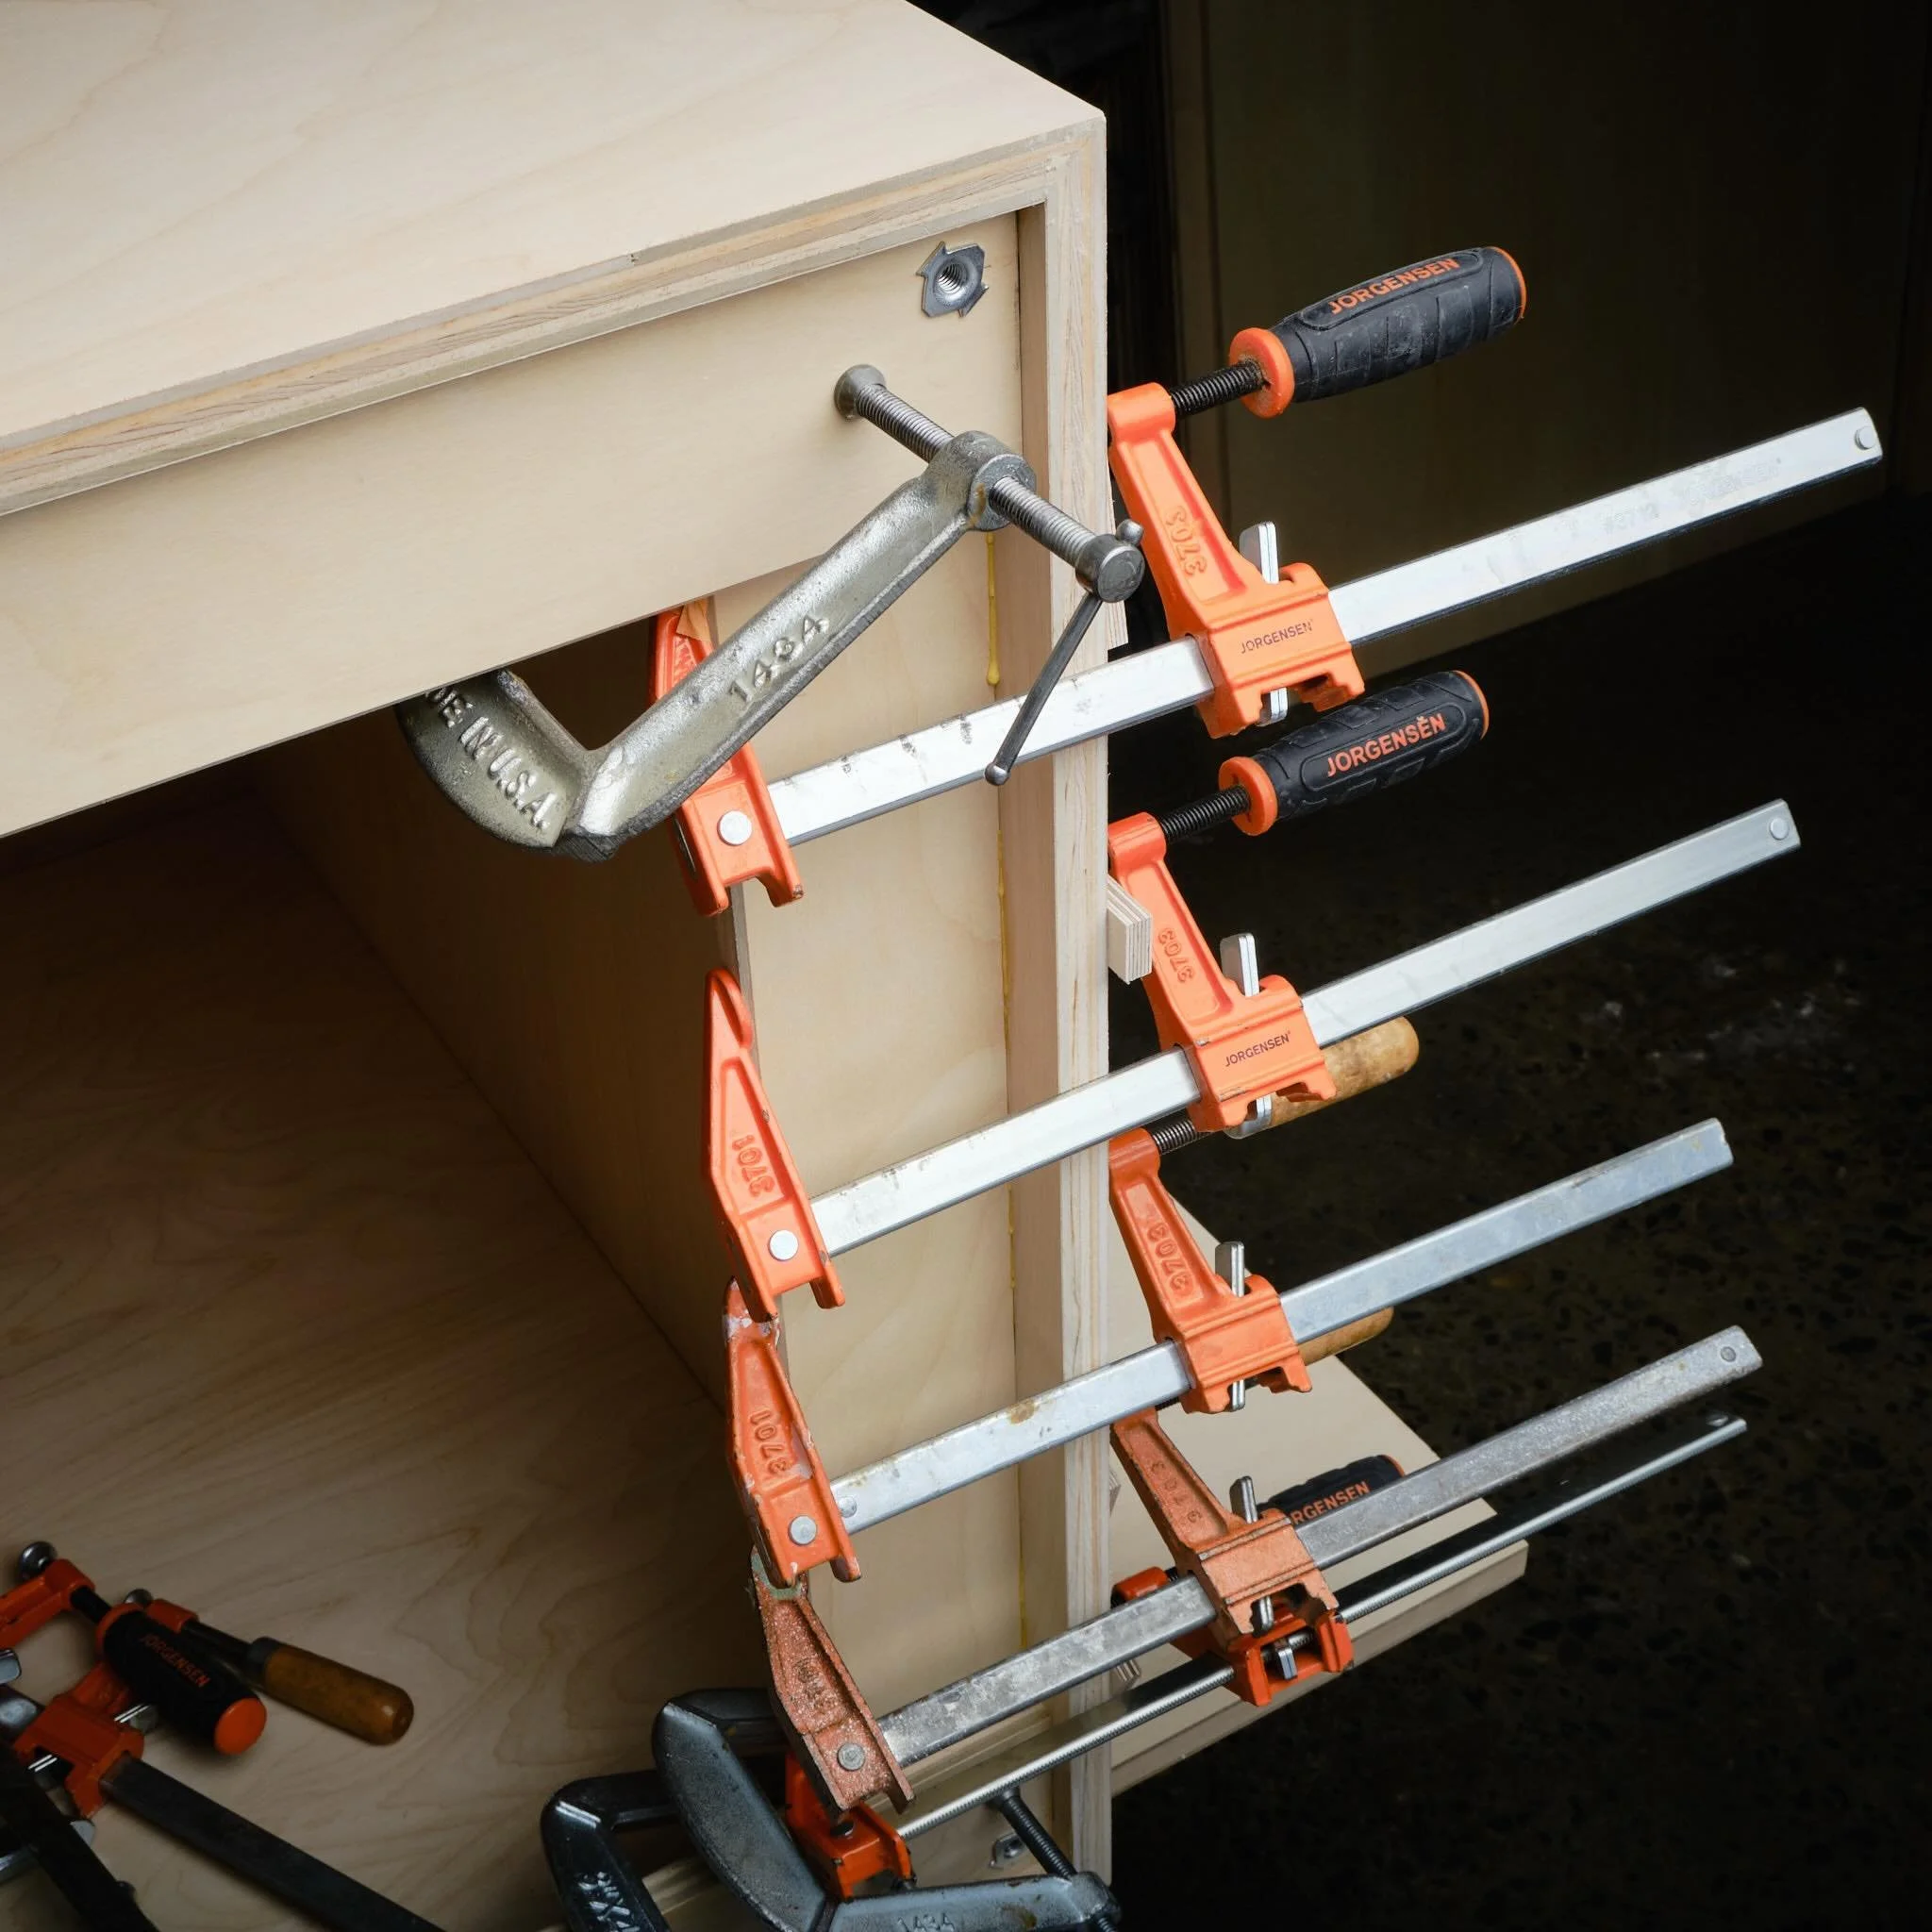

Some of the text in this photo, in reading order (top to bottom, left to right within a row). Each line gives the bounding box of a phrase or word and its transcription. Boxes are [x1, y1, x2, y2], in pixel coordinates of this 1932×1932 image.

[1329, 257, 1460, 315] JORGENSEN
[1165, 506, 1208, 578] 3703
[1241, 621, 1313, 654] JORGENSEN
[459, 716, 503, 759] IN
[1326, 712, 1446, 776] JORGENSEN
[1158, 927, 1195, 984] 3703
[1224, 1033, 1290, 1067] JORGENSEN
[731, 1134, 775, 1198] 3701
[1290, 1480, 1372, 1525] RGENSEN
